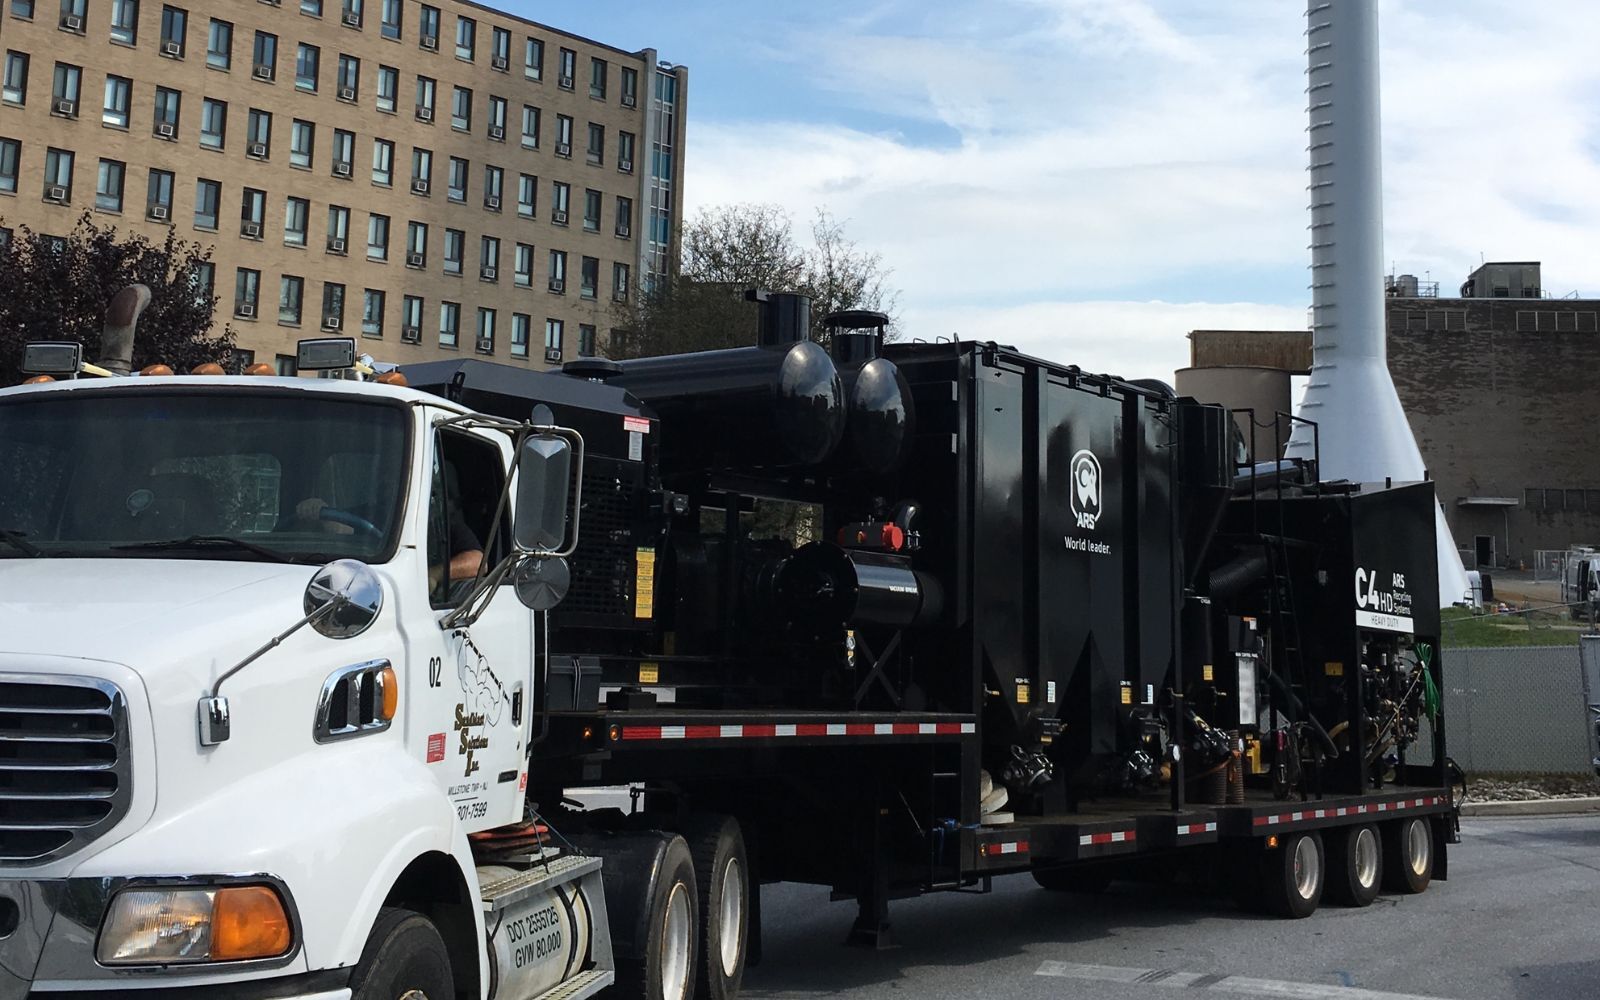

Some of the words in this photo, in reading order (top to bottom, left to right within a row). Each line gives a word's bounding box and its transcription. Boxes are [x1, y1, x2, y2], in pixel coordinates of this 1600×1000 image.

[1077, 511, 1095, 530] ARS
[1064, 535, 1086, 551] World
[1087, 539, 1112, 554] leader.
[1354, 567, 1380, 610] C4
[1379, 591, 1393, 613] HD
[1392, 572, 1405, 589] ARS
[1371, 614, 1386, 627] HEAVY
[1386, 616, 1400, 629] DUTY
[429, 656, 442, 689] 02
[506, 919, 527, 943] DOT
[525, 905, 559, 936] 2555725
[515, 942, 535, 969] GVW
[536, 930, 562, 959] 80,000
